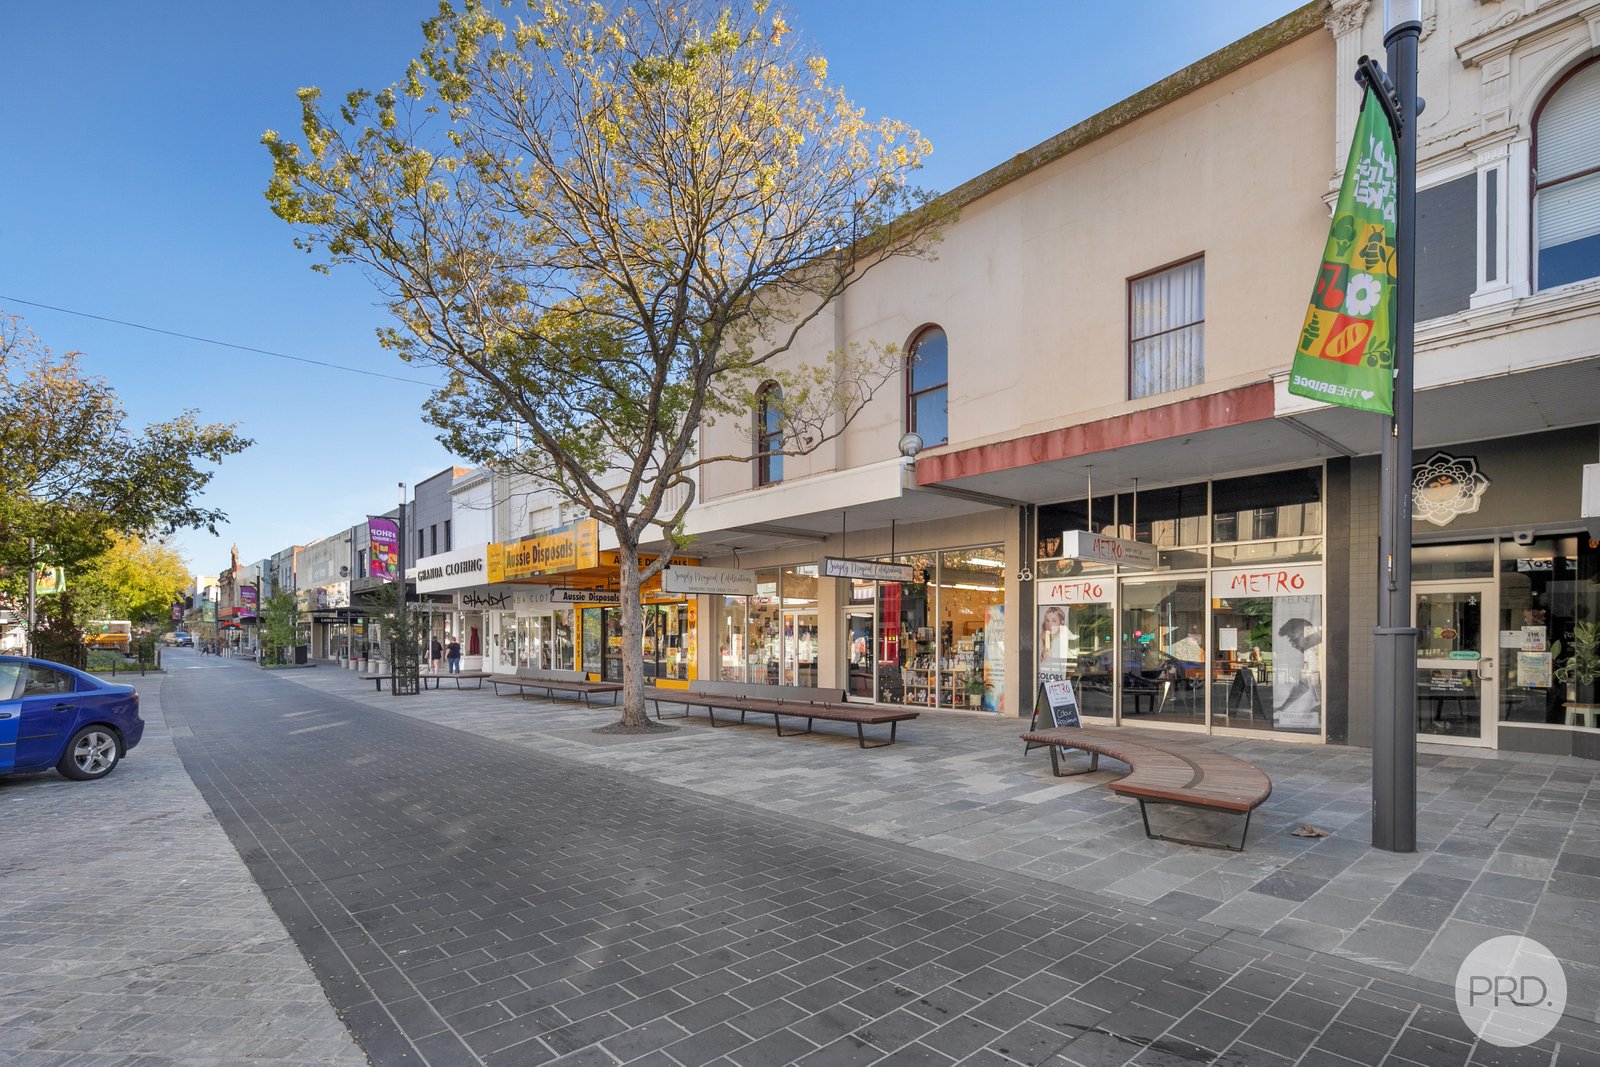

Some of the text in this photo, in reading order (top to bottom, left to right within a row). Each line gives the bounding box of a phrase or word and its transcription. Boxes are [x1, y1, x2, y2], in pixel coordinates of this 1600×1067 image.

[506, 545, 531, 569] Aussie
[532, 538, 573, 567] Disposals
[1093, 538, 1122, 560] METRO
[418, 566, 443, 581] GHANDA
[445, 558, 482, 576] CLOTHING
[674, 570, 692, 583] Simply
[828, 559, 849, 577] Simply
[1051, 582, 1103, 601] METRO
[1231, 571, 1305, 596] METRO
[563, 592, 620, 603] Aussie Disposals
[1049, 682, 1071, 696] METRO
